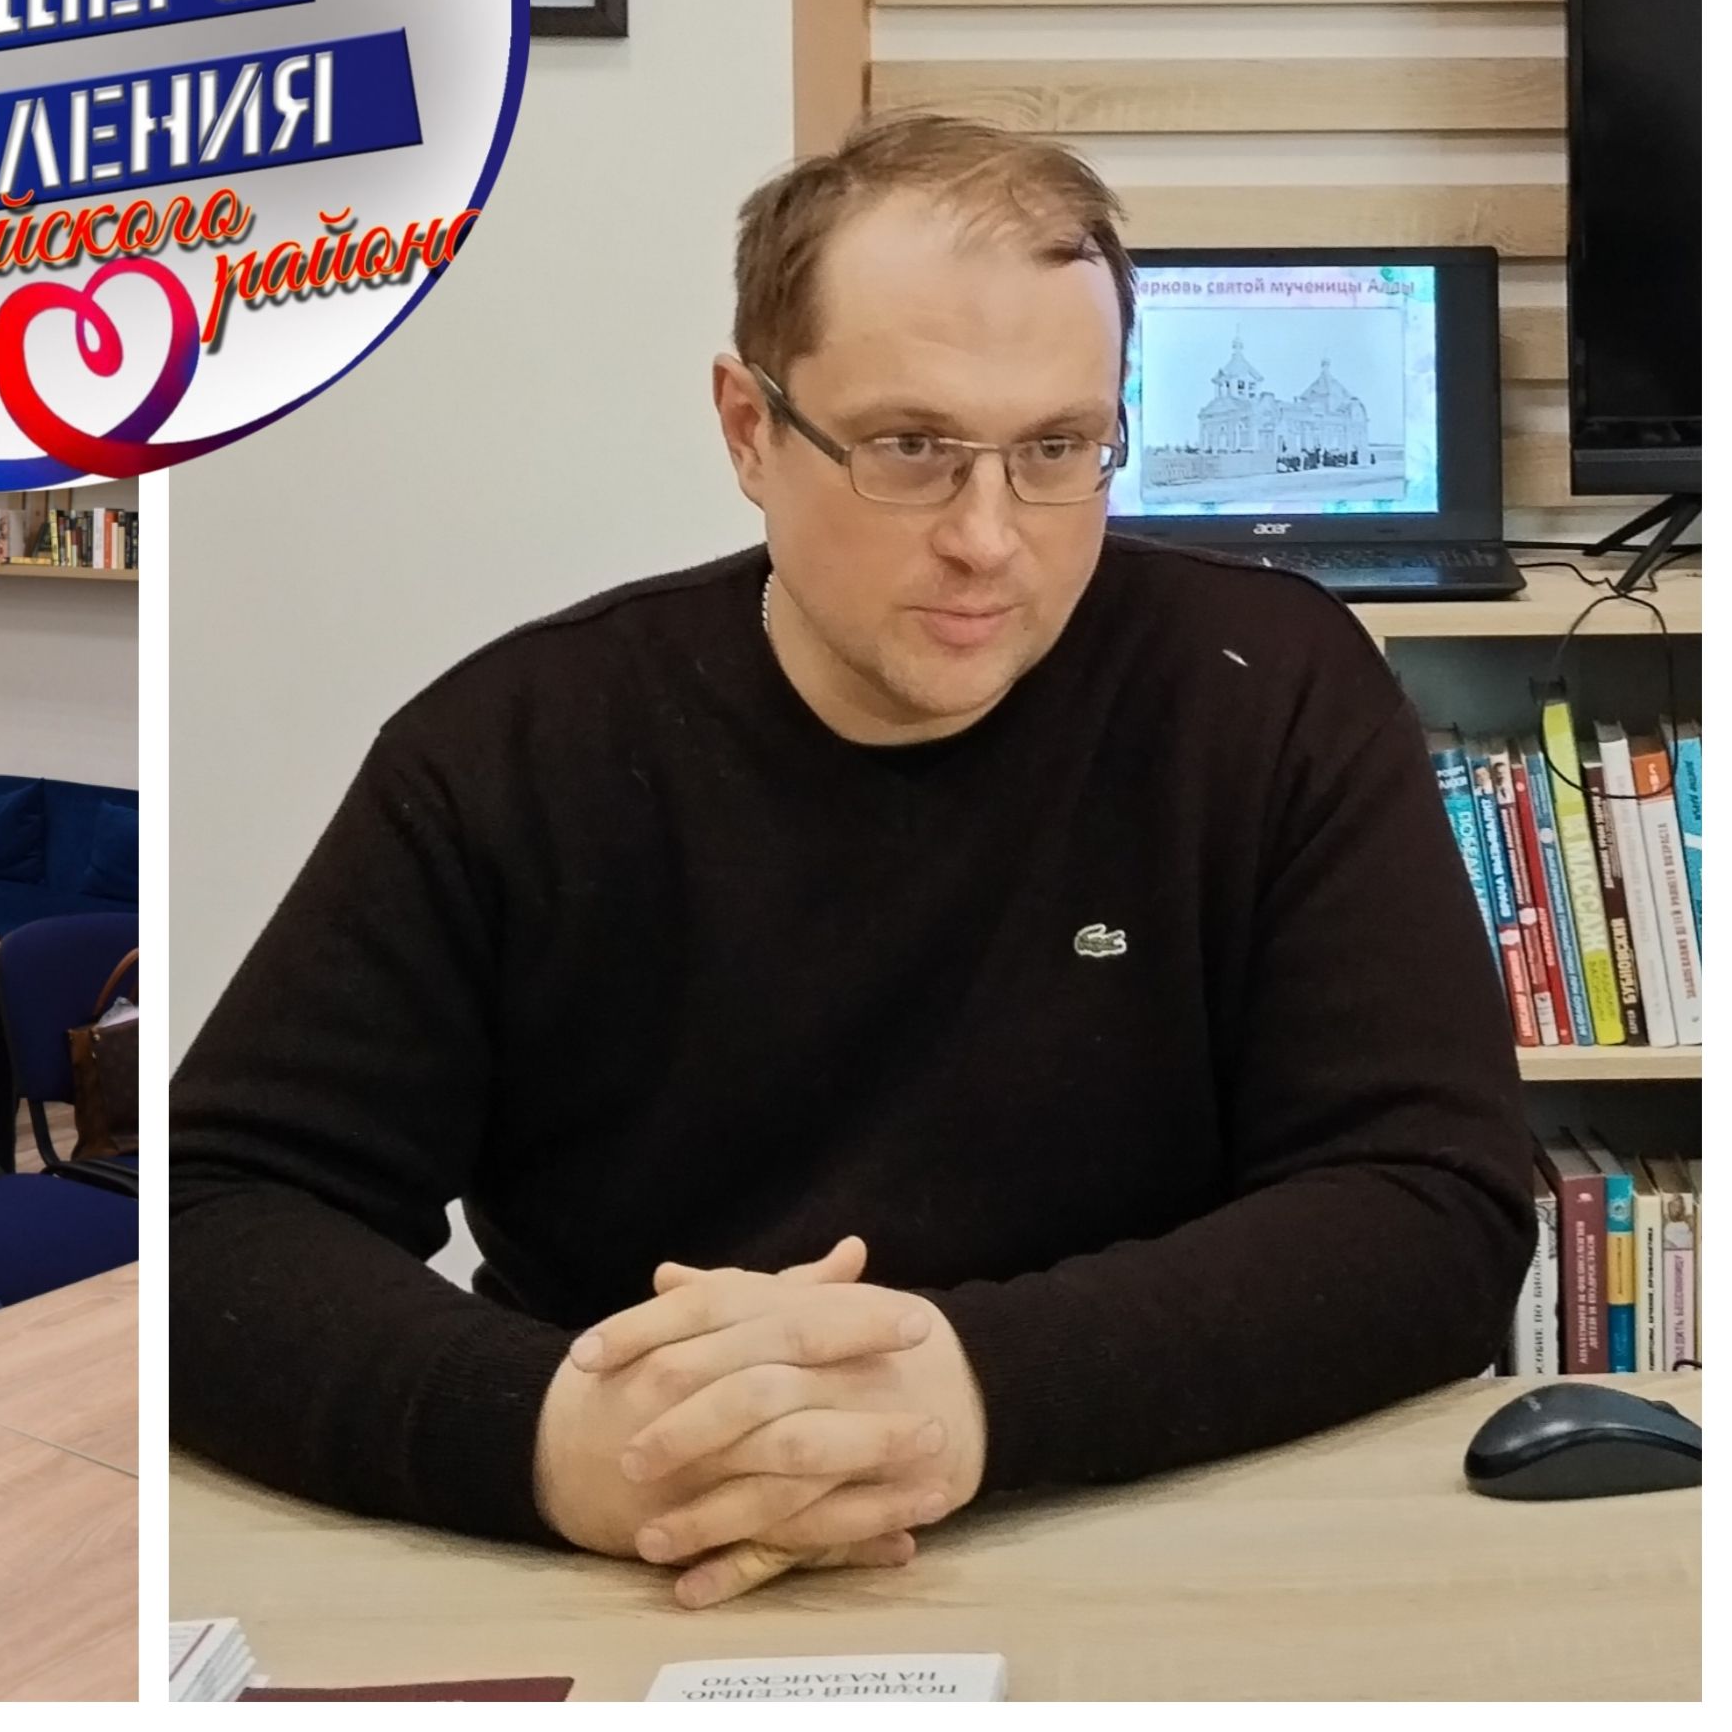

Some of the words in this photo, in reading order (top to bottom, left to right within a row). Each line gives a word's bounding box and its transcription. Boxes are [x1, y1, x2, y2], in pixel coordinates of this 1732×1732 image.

[1137, 279, 1202, 296] ерковь
[1207, 277, 1265, 295] святой
[1270, 280, 1362, 297] мученицы
[1367, 279, 1415, 295] Аллы
[1253, 523, 1291, 534] acer
[1565, 844, 1609, 950] МАССАЖ
[1611, 917, 1637, 1004] БУБНОВСКИЙ
[701, 1673, 887, 1688] КАЗАНСКУЮ
[897, 1671, 936, 1682] НА
[824, 1684, 957, 1697] ПОЗДНЕЙ
